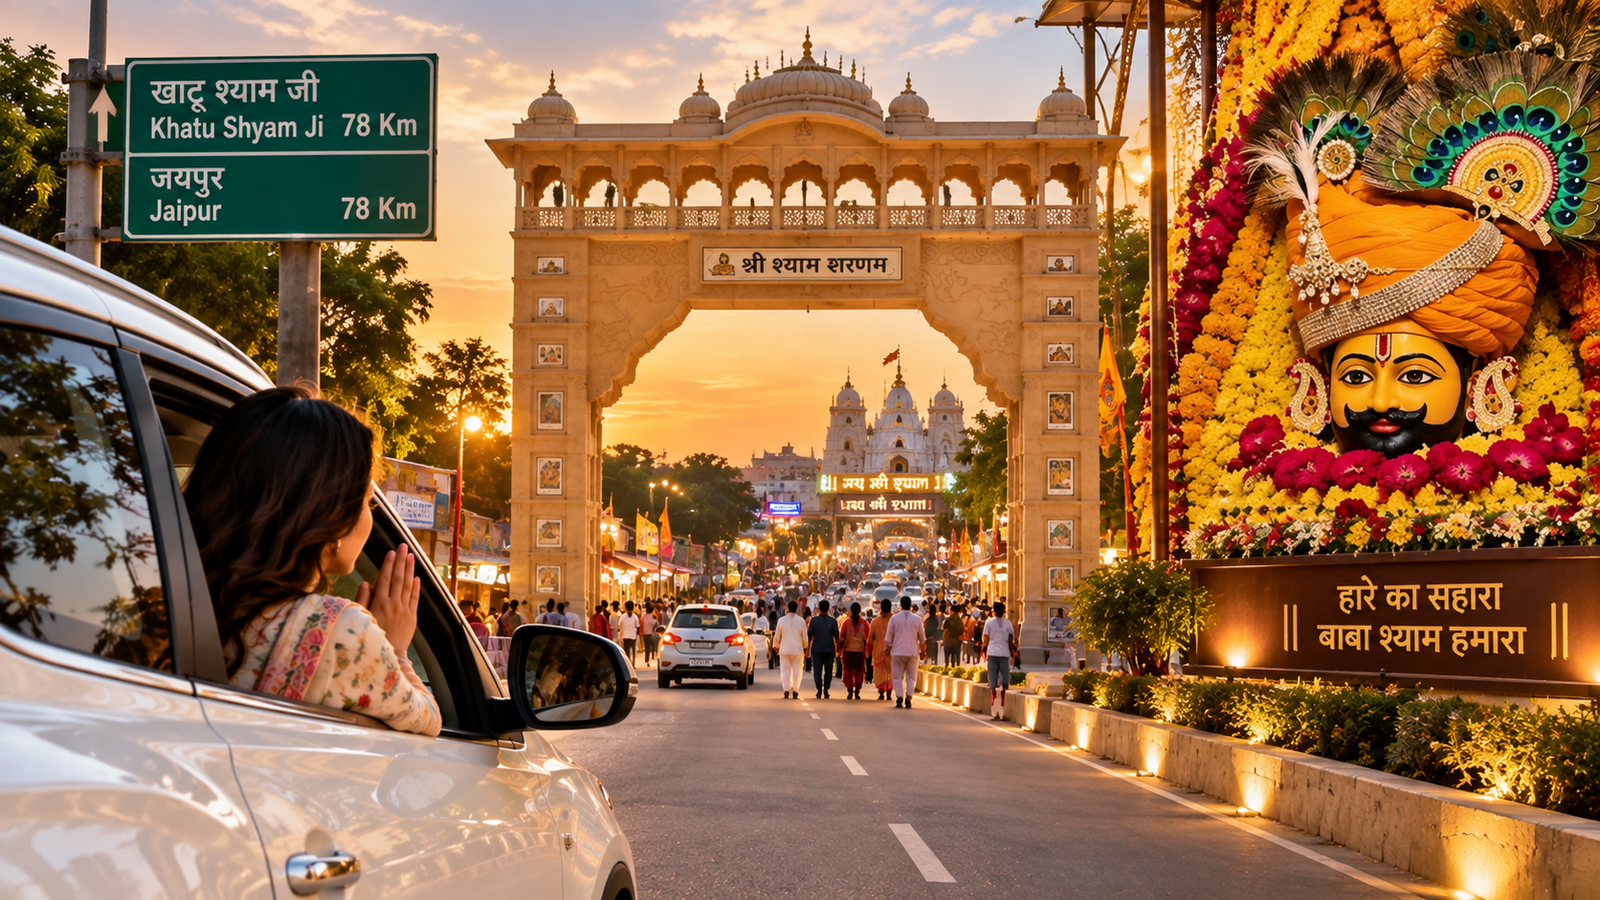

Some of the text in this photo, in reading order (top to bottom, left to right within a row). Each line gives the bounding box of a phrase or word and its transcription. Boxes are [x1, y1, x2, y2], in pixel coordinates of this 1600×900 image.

[150, 70, 320, 112] खाटू श्याम जी
[152, 113, 416, 144] Khatu Shyam Ji 78 Km
[150, 168, 225, 198] जयपुर
[150, 197, 415, 226] Jaipur 78 Km
[742, 252, 888, 273] श्री श्याम शरणम
[1337, 575, 1503, 614] हारे का सहारा
[1317, 625, 1527, 657] बाबा श्याम हमारा
